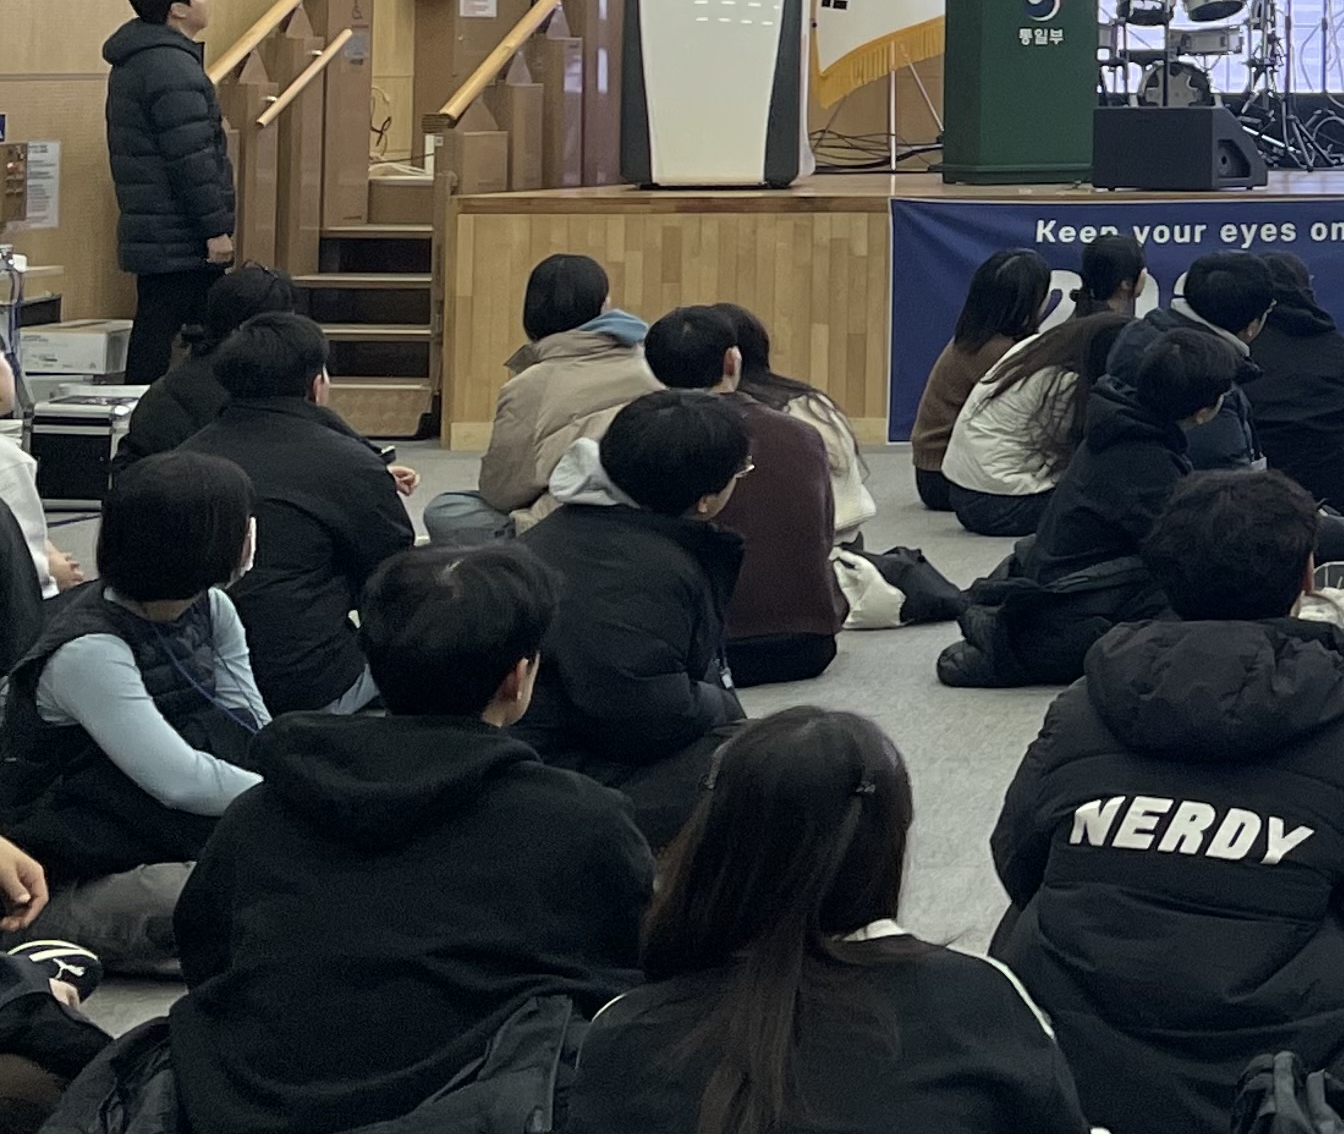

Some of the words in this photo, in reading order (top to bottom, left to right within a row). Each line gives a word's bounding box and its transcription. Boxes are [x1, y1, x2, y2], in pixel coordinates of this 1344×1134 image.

[1019, 28, 1064, 46] 통일부
[1219, 222, 1297, 248] eyes
[1069, 795, 1315, 865] NERDY
